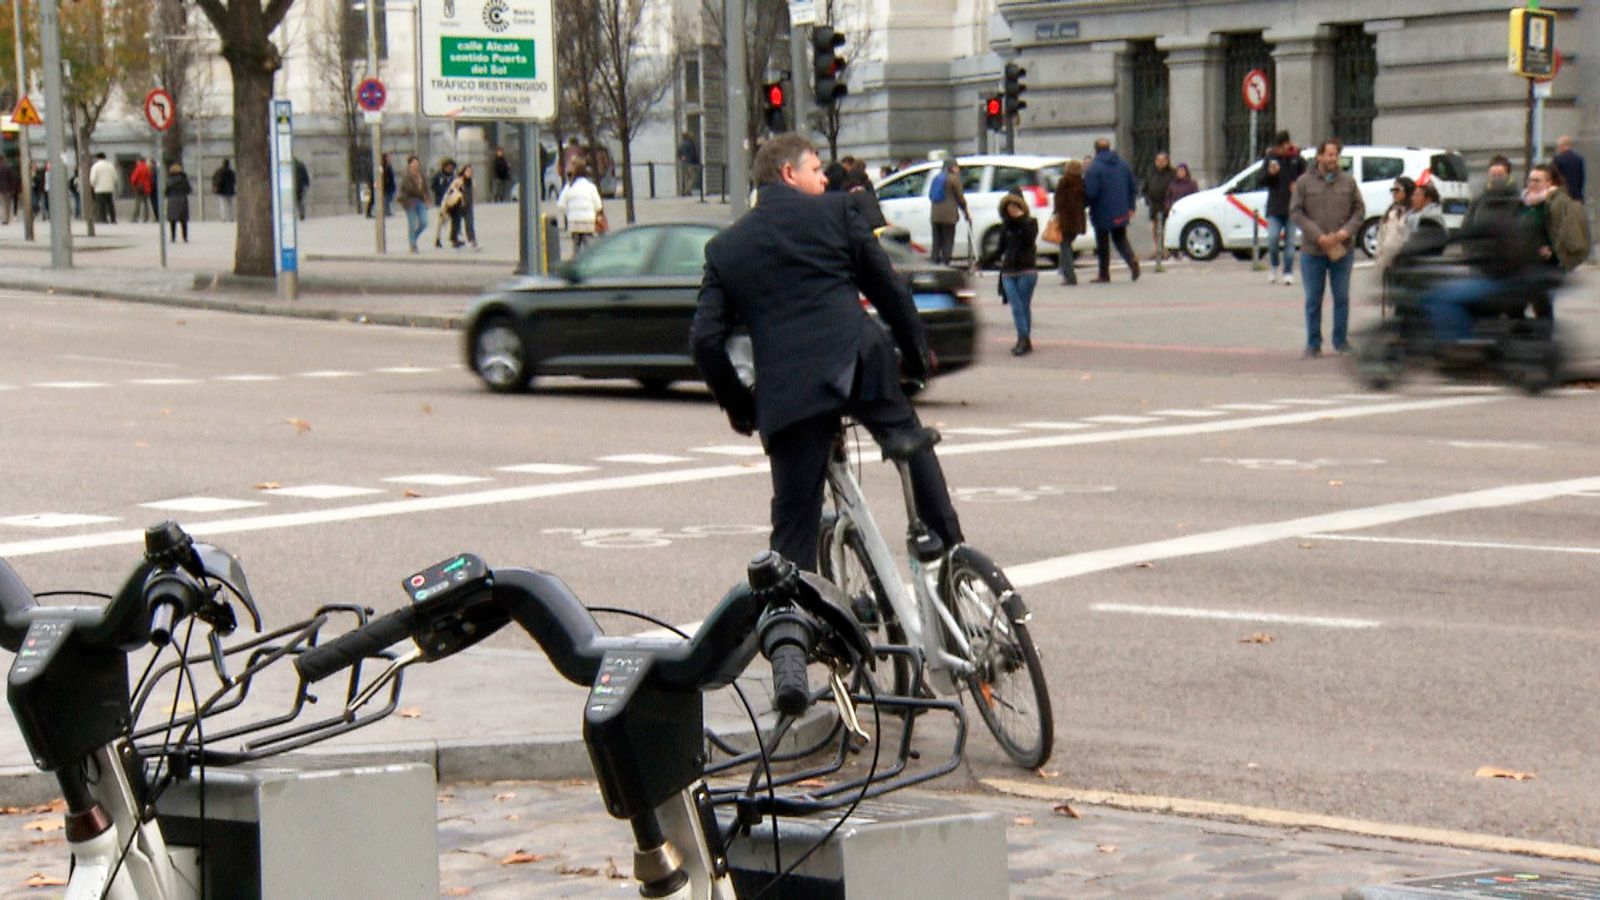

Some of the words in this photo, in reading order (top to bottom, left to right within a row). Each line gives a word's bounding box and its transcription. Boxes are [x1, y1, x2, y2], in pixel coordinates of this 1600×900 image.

[457, 41, 483, 51] calle
[449, 53, 490, 63] sentido
[492, 53, 527, 64] Puerta
[471, 64, 487, 74] del
[490, 64, 507, 75] Sol
[478, 81, 547, 92] RESTRINGIDO
[447, 95, 485, 103] EXCEPTO
